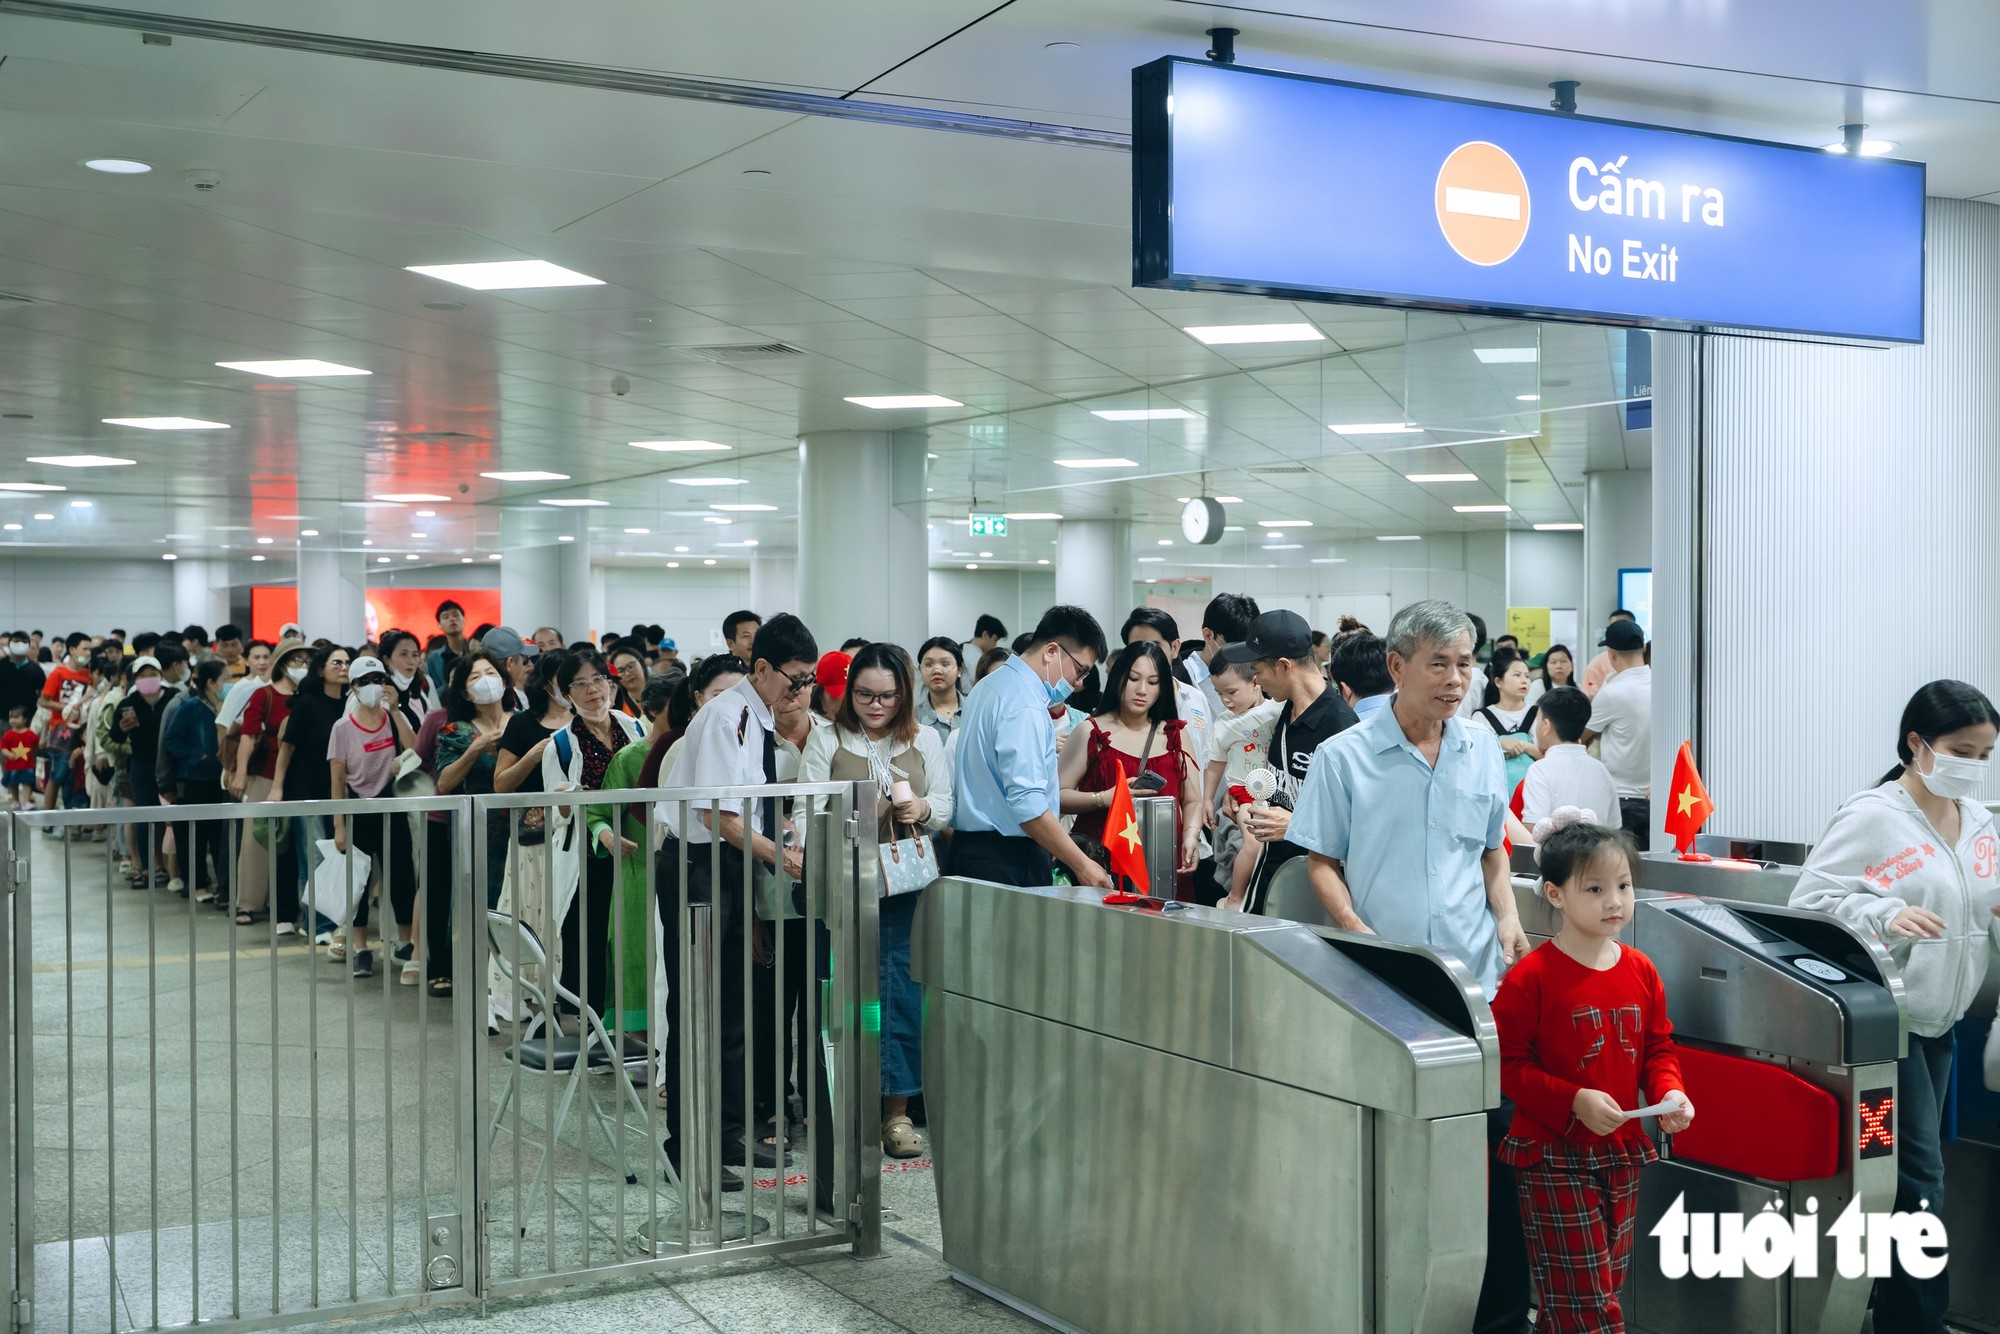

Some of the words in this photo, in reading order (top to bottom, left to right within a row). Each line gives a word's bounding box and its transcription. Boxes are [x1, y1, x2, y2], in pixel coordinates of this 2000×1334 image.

[1568, 155, 1666, 221] Cấm
[1681, 183, 1724, 227] ra
[1568, 233, 1612, 276] No
[1622, 239, 1679, 282] Exit
